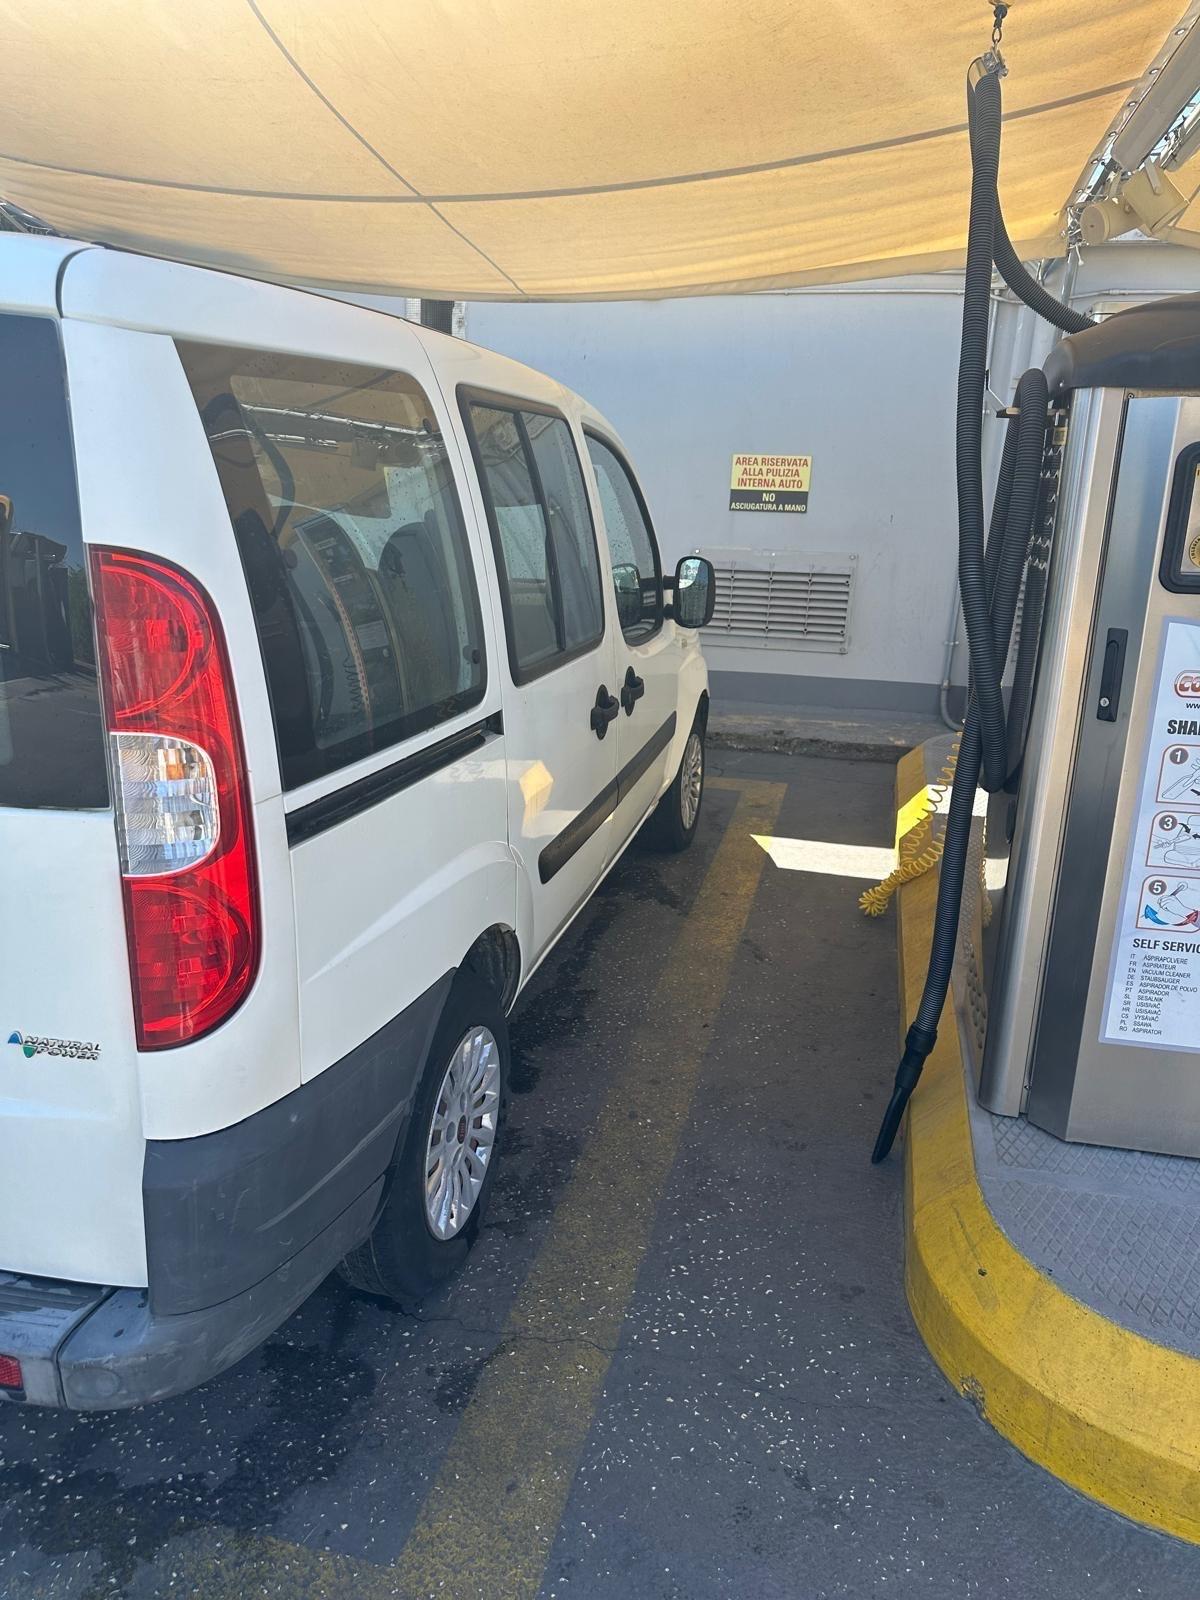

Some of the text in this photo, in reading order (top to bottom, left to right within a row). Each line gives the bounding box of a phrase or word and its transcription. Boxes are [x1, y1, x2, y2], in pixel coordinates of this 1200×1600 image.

[736, 457, 808, 467] AREA RISERVATA
[742, 468, 800, 477] ALLA PULIZIA
[737, 478, 803, 488] INTERNA AUTO
[762, 493, 775, 502] NO
[731, 502, 777, 511] ASCIUGATURA
[1167, 720, 1200, 735] SHA
[1164, 818, 1172, 829] 3
[1153, 882, 1161, 893] 5
[1133, 938, 1160, 950] SELF
[1144, 955, 1188, 965] ASPIRAPOLVERE
[1143, 962, 1176, 970] ASPIRATEUR
[1139, 982, 1170, 990] ASPIRADOR
[24, 1036, 101, 1051] NATURAL
[37, 1046, 100, 1060] POWER
